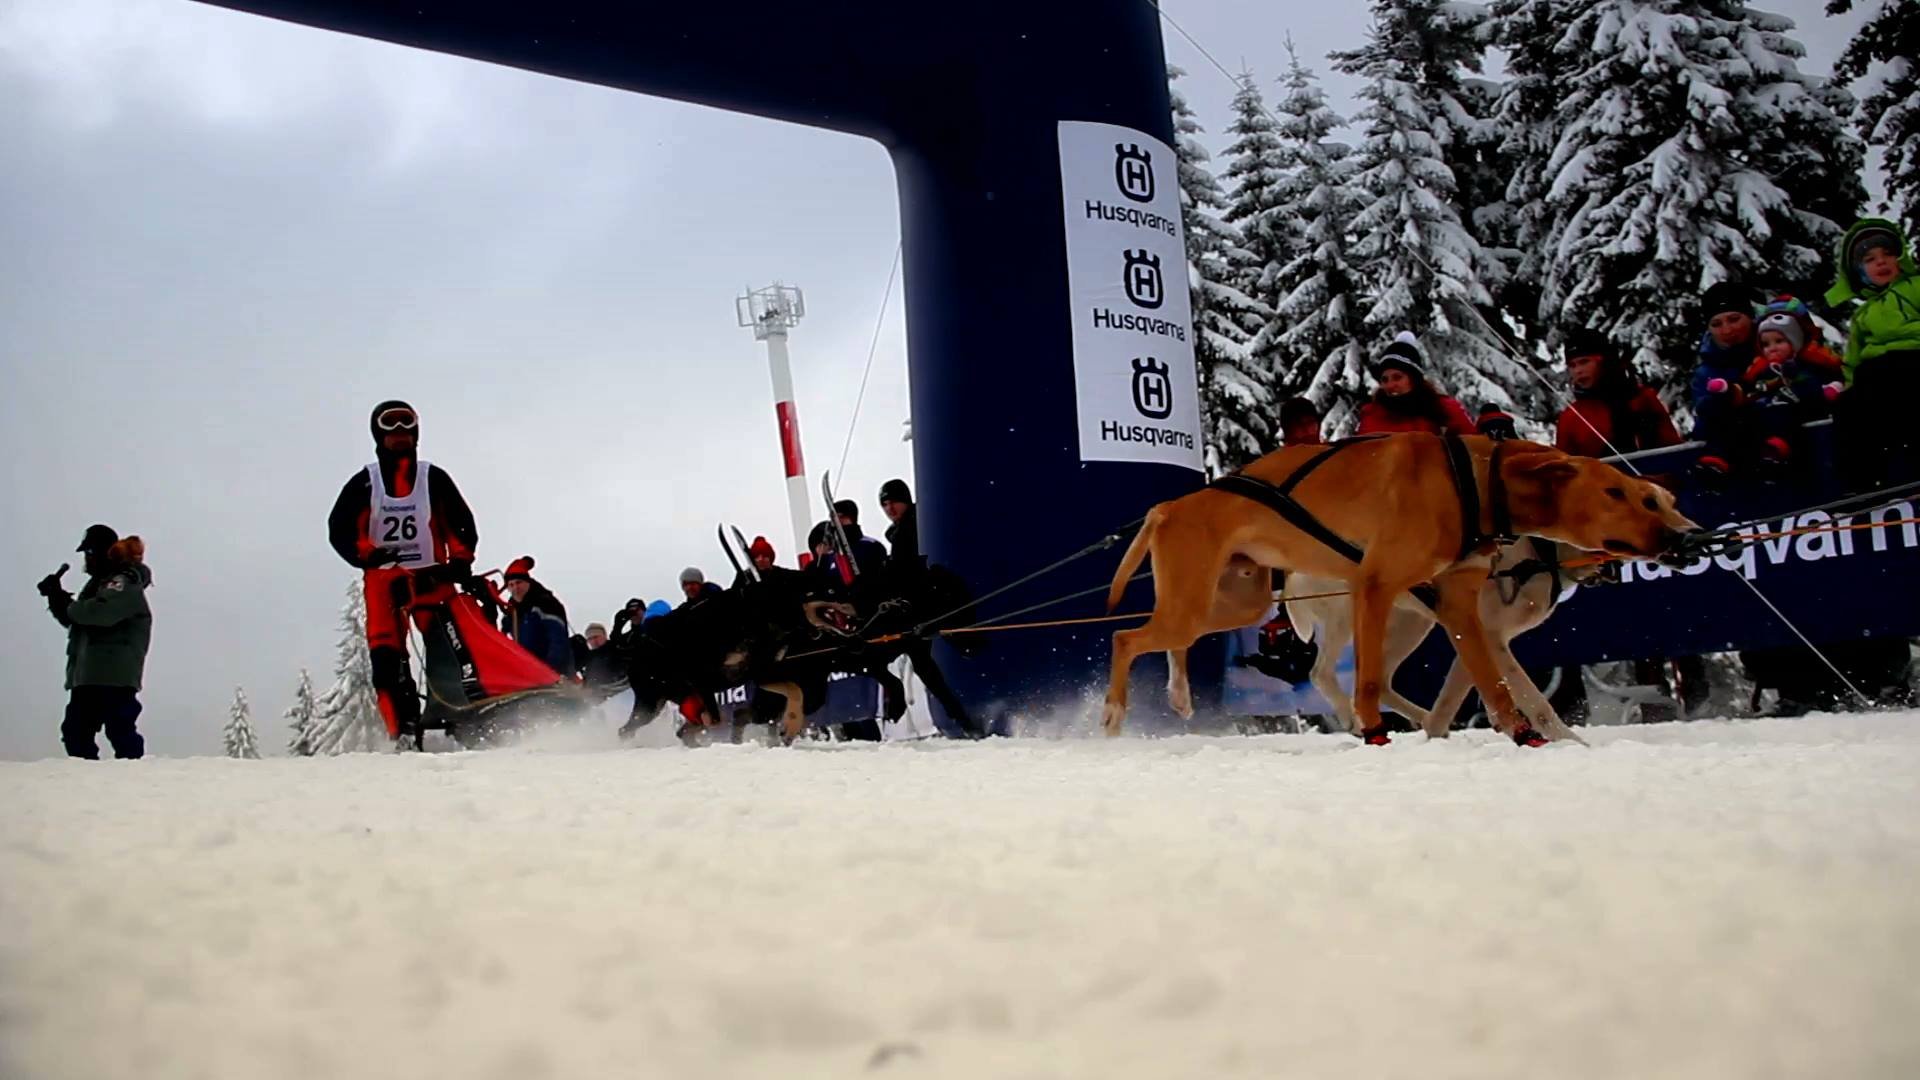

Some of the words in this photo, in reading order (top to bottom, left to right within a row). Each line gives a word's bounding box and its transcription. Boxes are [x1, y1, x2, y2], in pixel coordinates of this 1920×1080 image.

[1126, 161, 1147, 192] H
[1085, 200, 1176, 236] Husqvarna
[1134, 267, 1155, 298] H
[1093, 308, 1186, 342] Husqvarna
[1143, 376, 1164, 408] H
[1101, 420, 1194, 450] Husqvarna
[383, 515, 418, 541] 26
